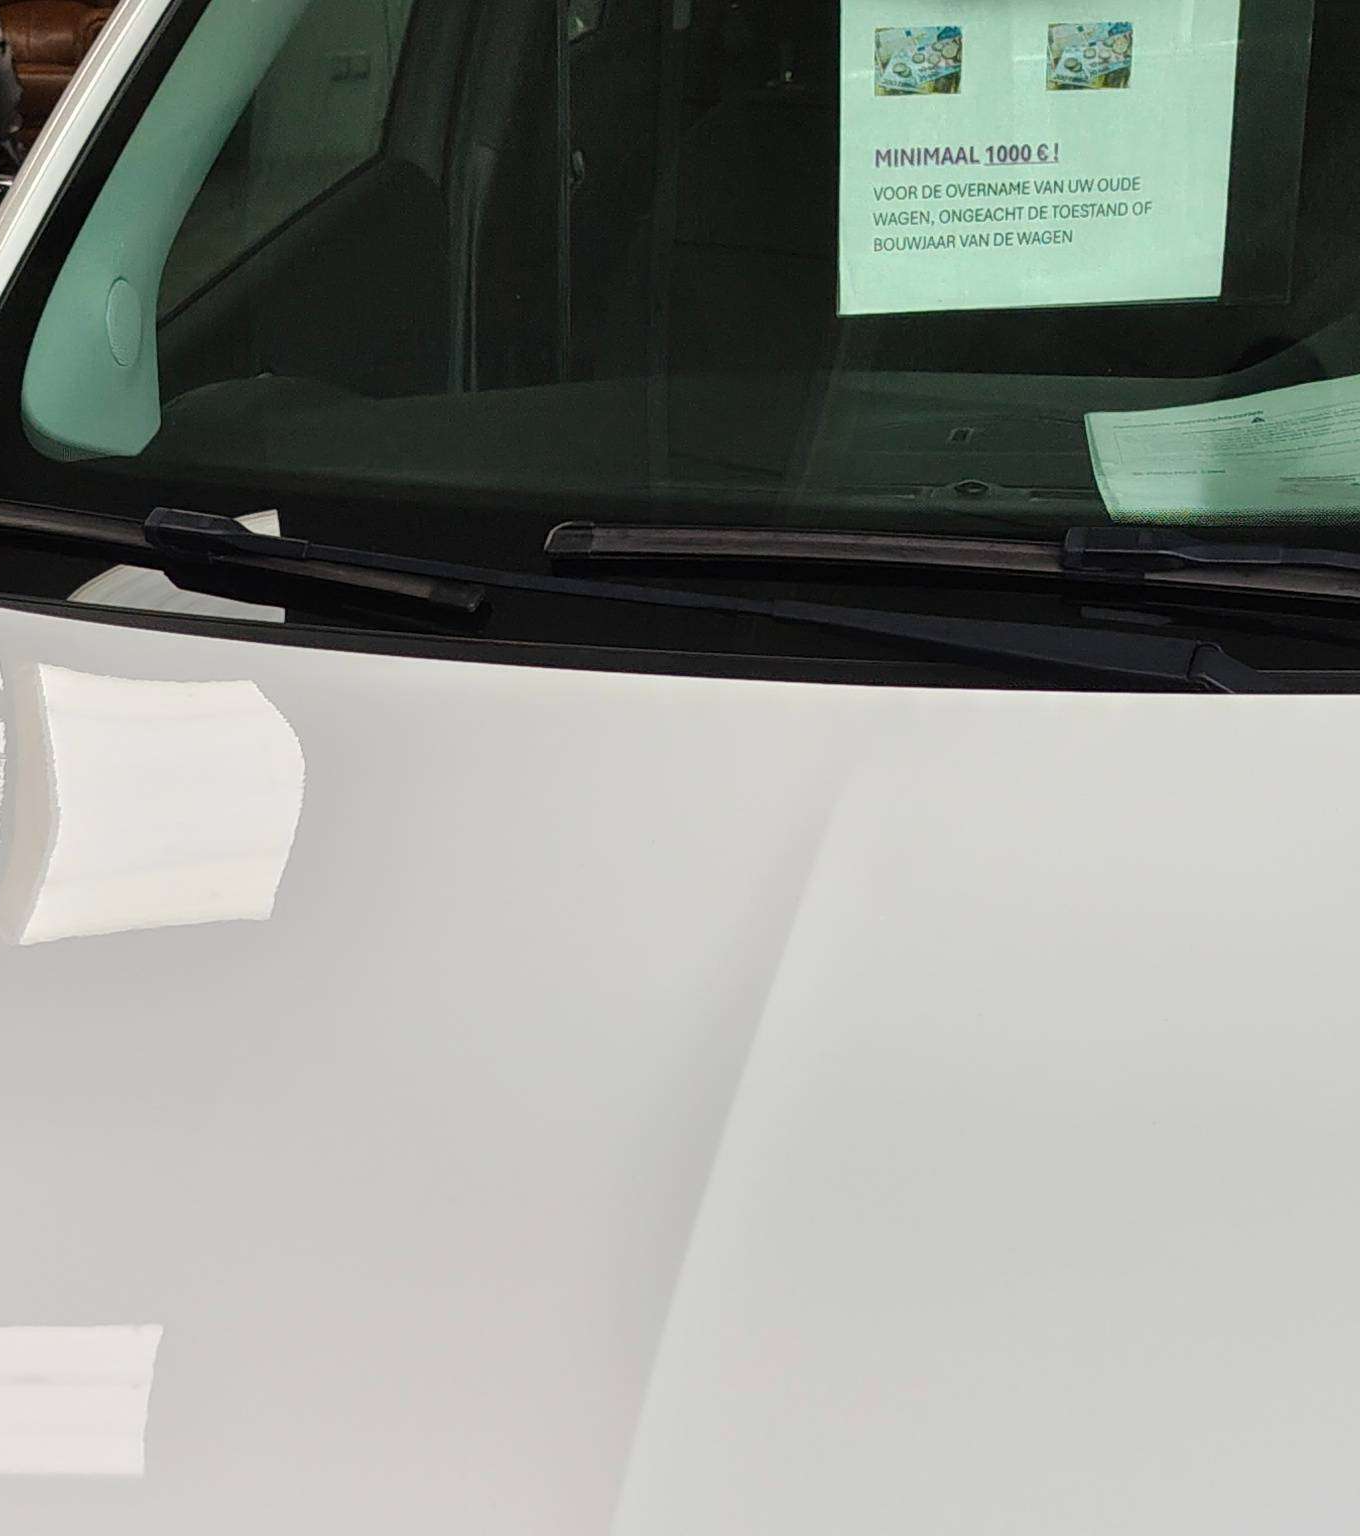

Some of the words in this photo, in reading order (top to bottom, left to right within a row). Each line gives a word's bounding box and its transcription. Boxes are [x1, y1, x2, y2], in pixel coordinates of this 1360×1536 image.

[875, 146, 980, 168] MINIMAAL
[985, 144, 1032, 163] 1000
[1037, 143, 1049, 161] €
[1053, 143, 1060, 161] !
[873, 185, 918, 201] VOOR
[923, 184, 942, 199] DE
[946, 180, 1031, 198] OVERNAME
[1034, 180, 1064, 195] VAN
[1068, 179, 1095, 193] UW
[1097, 176, 1141, 192] OUDE
[872, 210, 934, 226] WAGEN,
[938, 207, 1025, 224] ONGEACHT
[1028, 206, 1048, 220] DE
[1052, 202, 1128, 219] TOESTAND
[1132, 201, 1153, 216] OF
[874, 235, 956, 252] BOUWJAAR
[959, 234, 990, 248] VAN
[993, 232, 1014, 247] DE
[1017, 230, 1073, 246] WAGEN
